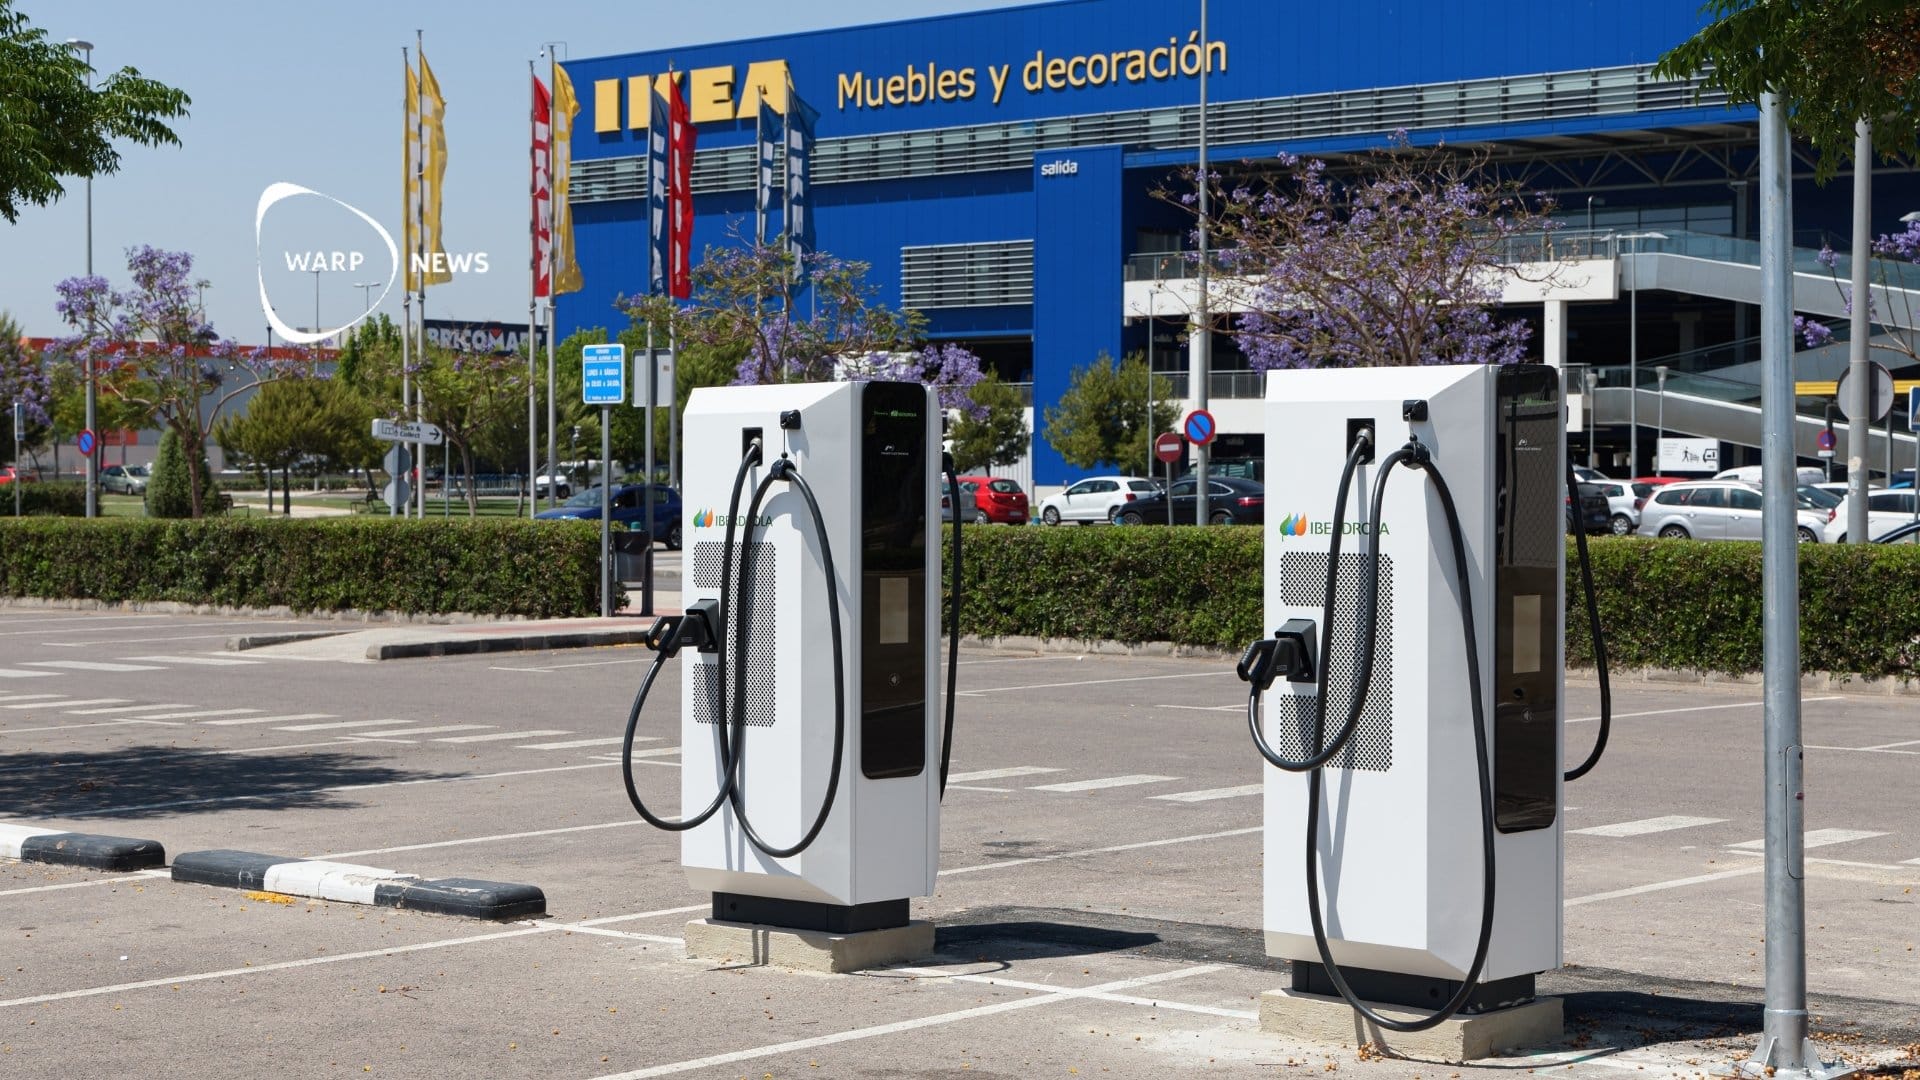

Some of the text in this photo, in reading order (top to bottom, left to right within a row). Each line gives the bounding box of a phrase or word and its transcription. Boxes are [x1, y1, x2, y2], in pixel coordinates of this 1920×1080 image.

[838, 30, 1227, 109] Muebles y decoración
[594, 59, 795, 133] IKEA
[1041, 159, 1078, 176] salida
[715, 515, 773, 527] IBEDOLA
[1310, 522, 1390, 535] IBEDROA
